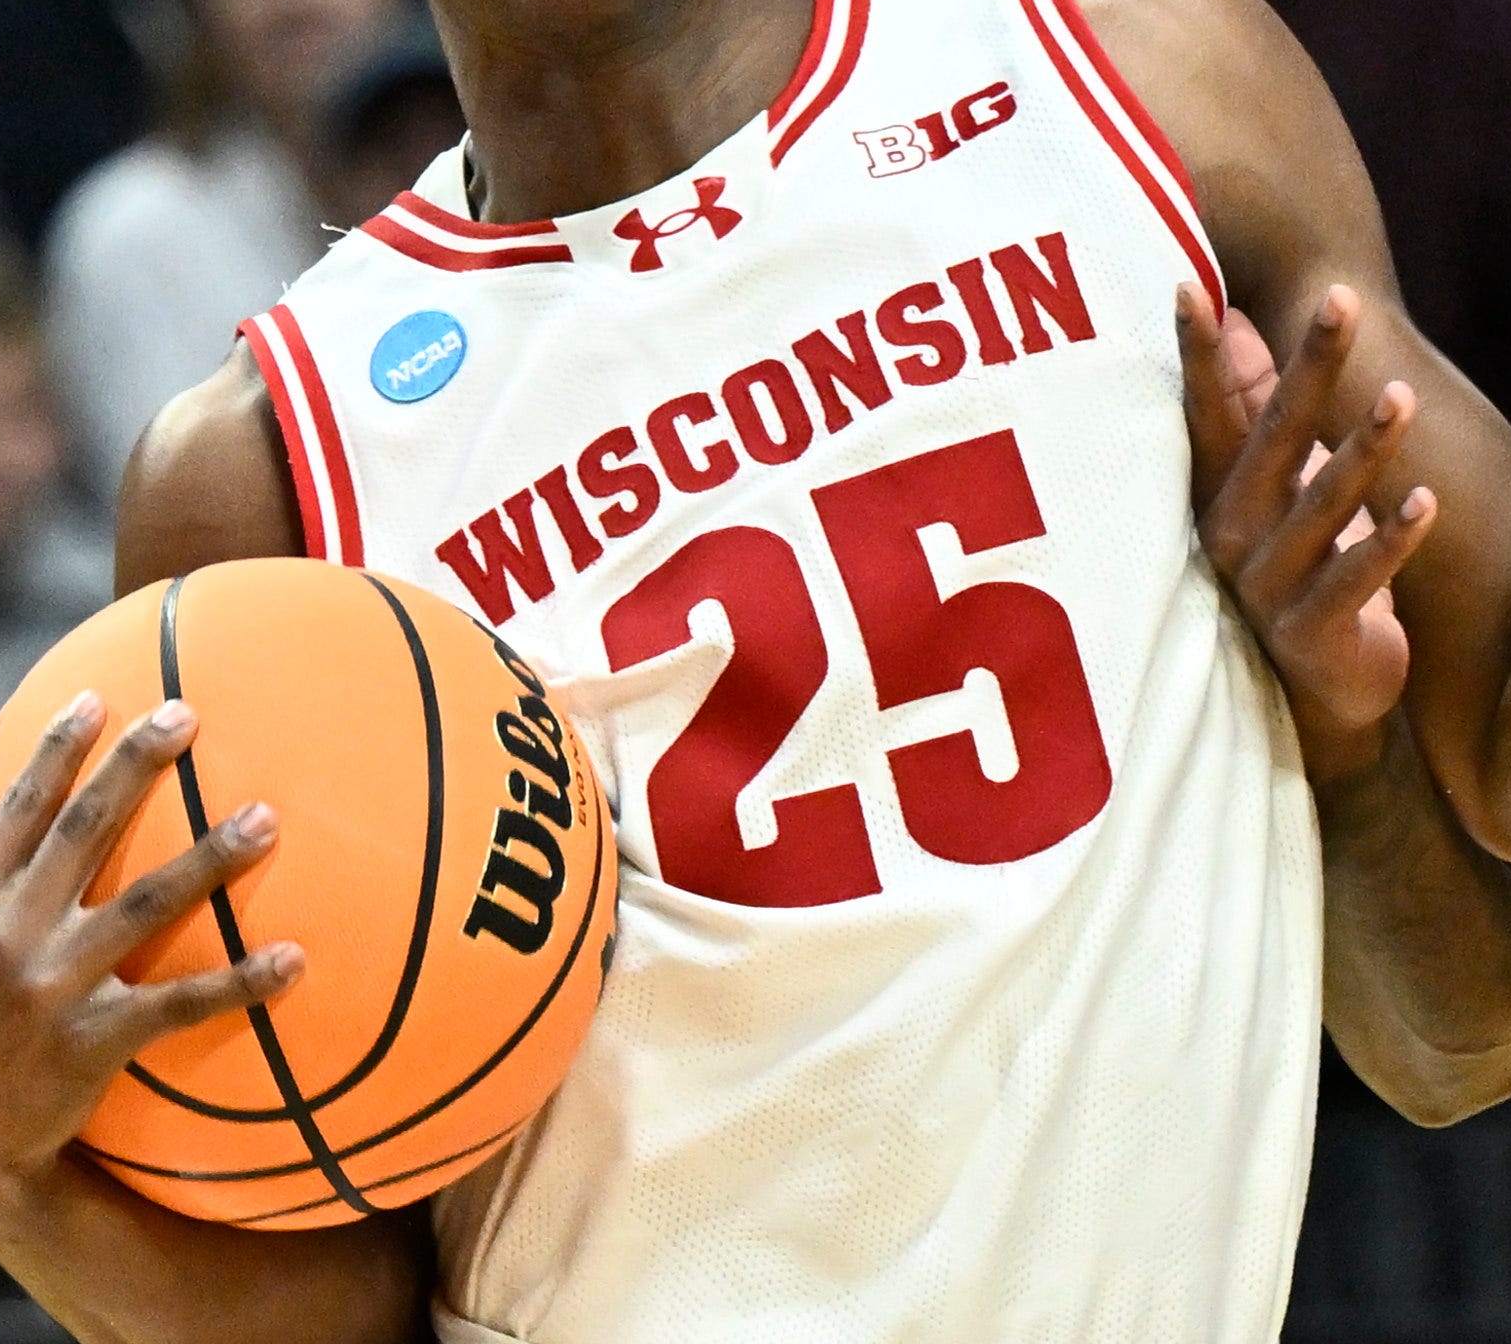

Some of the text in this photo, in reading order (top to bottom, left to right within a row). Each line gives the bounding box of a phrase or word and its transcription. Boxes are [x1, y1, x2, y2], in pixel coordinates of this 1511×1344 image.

[386, 330, 463, 391] NCAA
[434, 231, 1096, 629] WISCONSIN
[462, 617, 574, 956] Wilso
[600, 427, 1113, 910] 25
